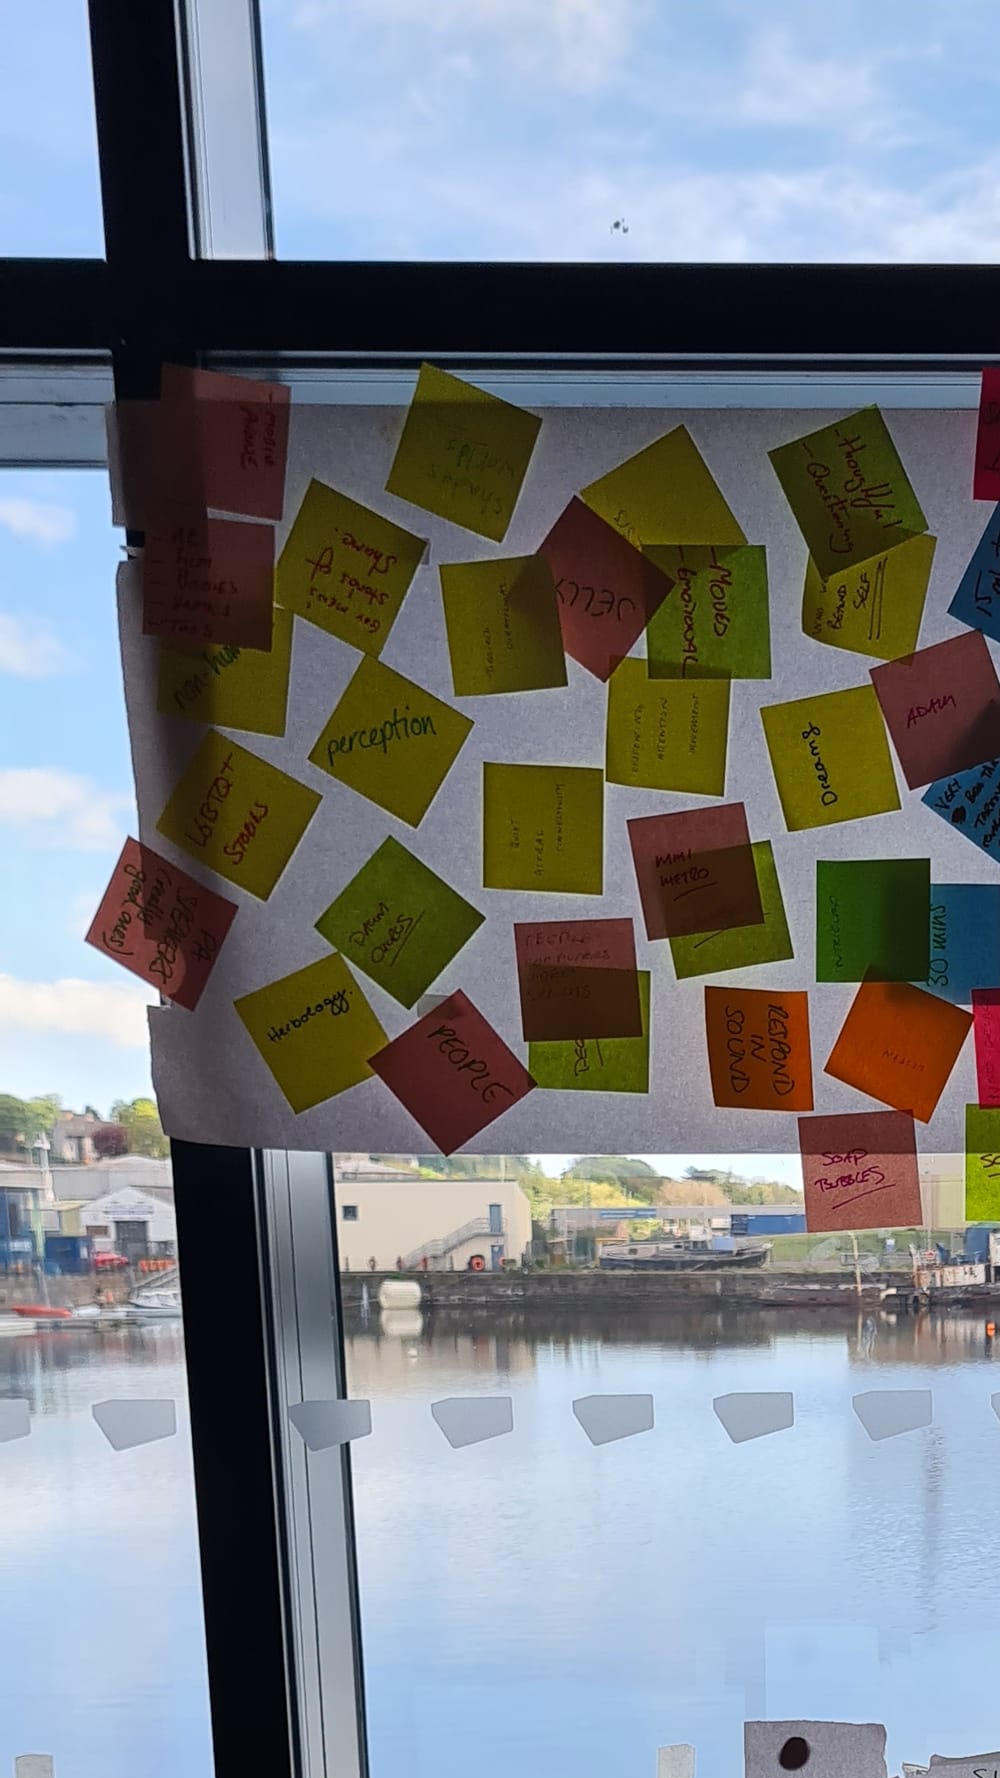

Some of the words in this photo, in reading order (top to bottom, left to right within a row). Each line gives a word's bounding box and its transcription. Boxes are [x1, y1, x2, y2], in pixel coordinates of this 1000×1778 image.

[324, 702, 439, 768] perception
[425, 1022, 518, 1105] PEOPLE
[723, 1004, 751, 1095] SOUND
